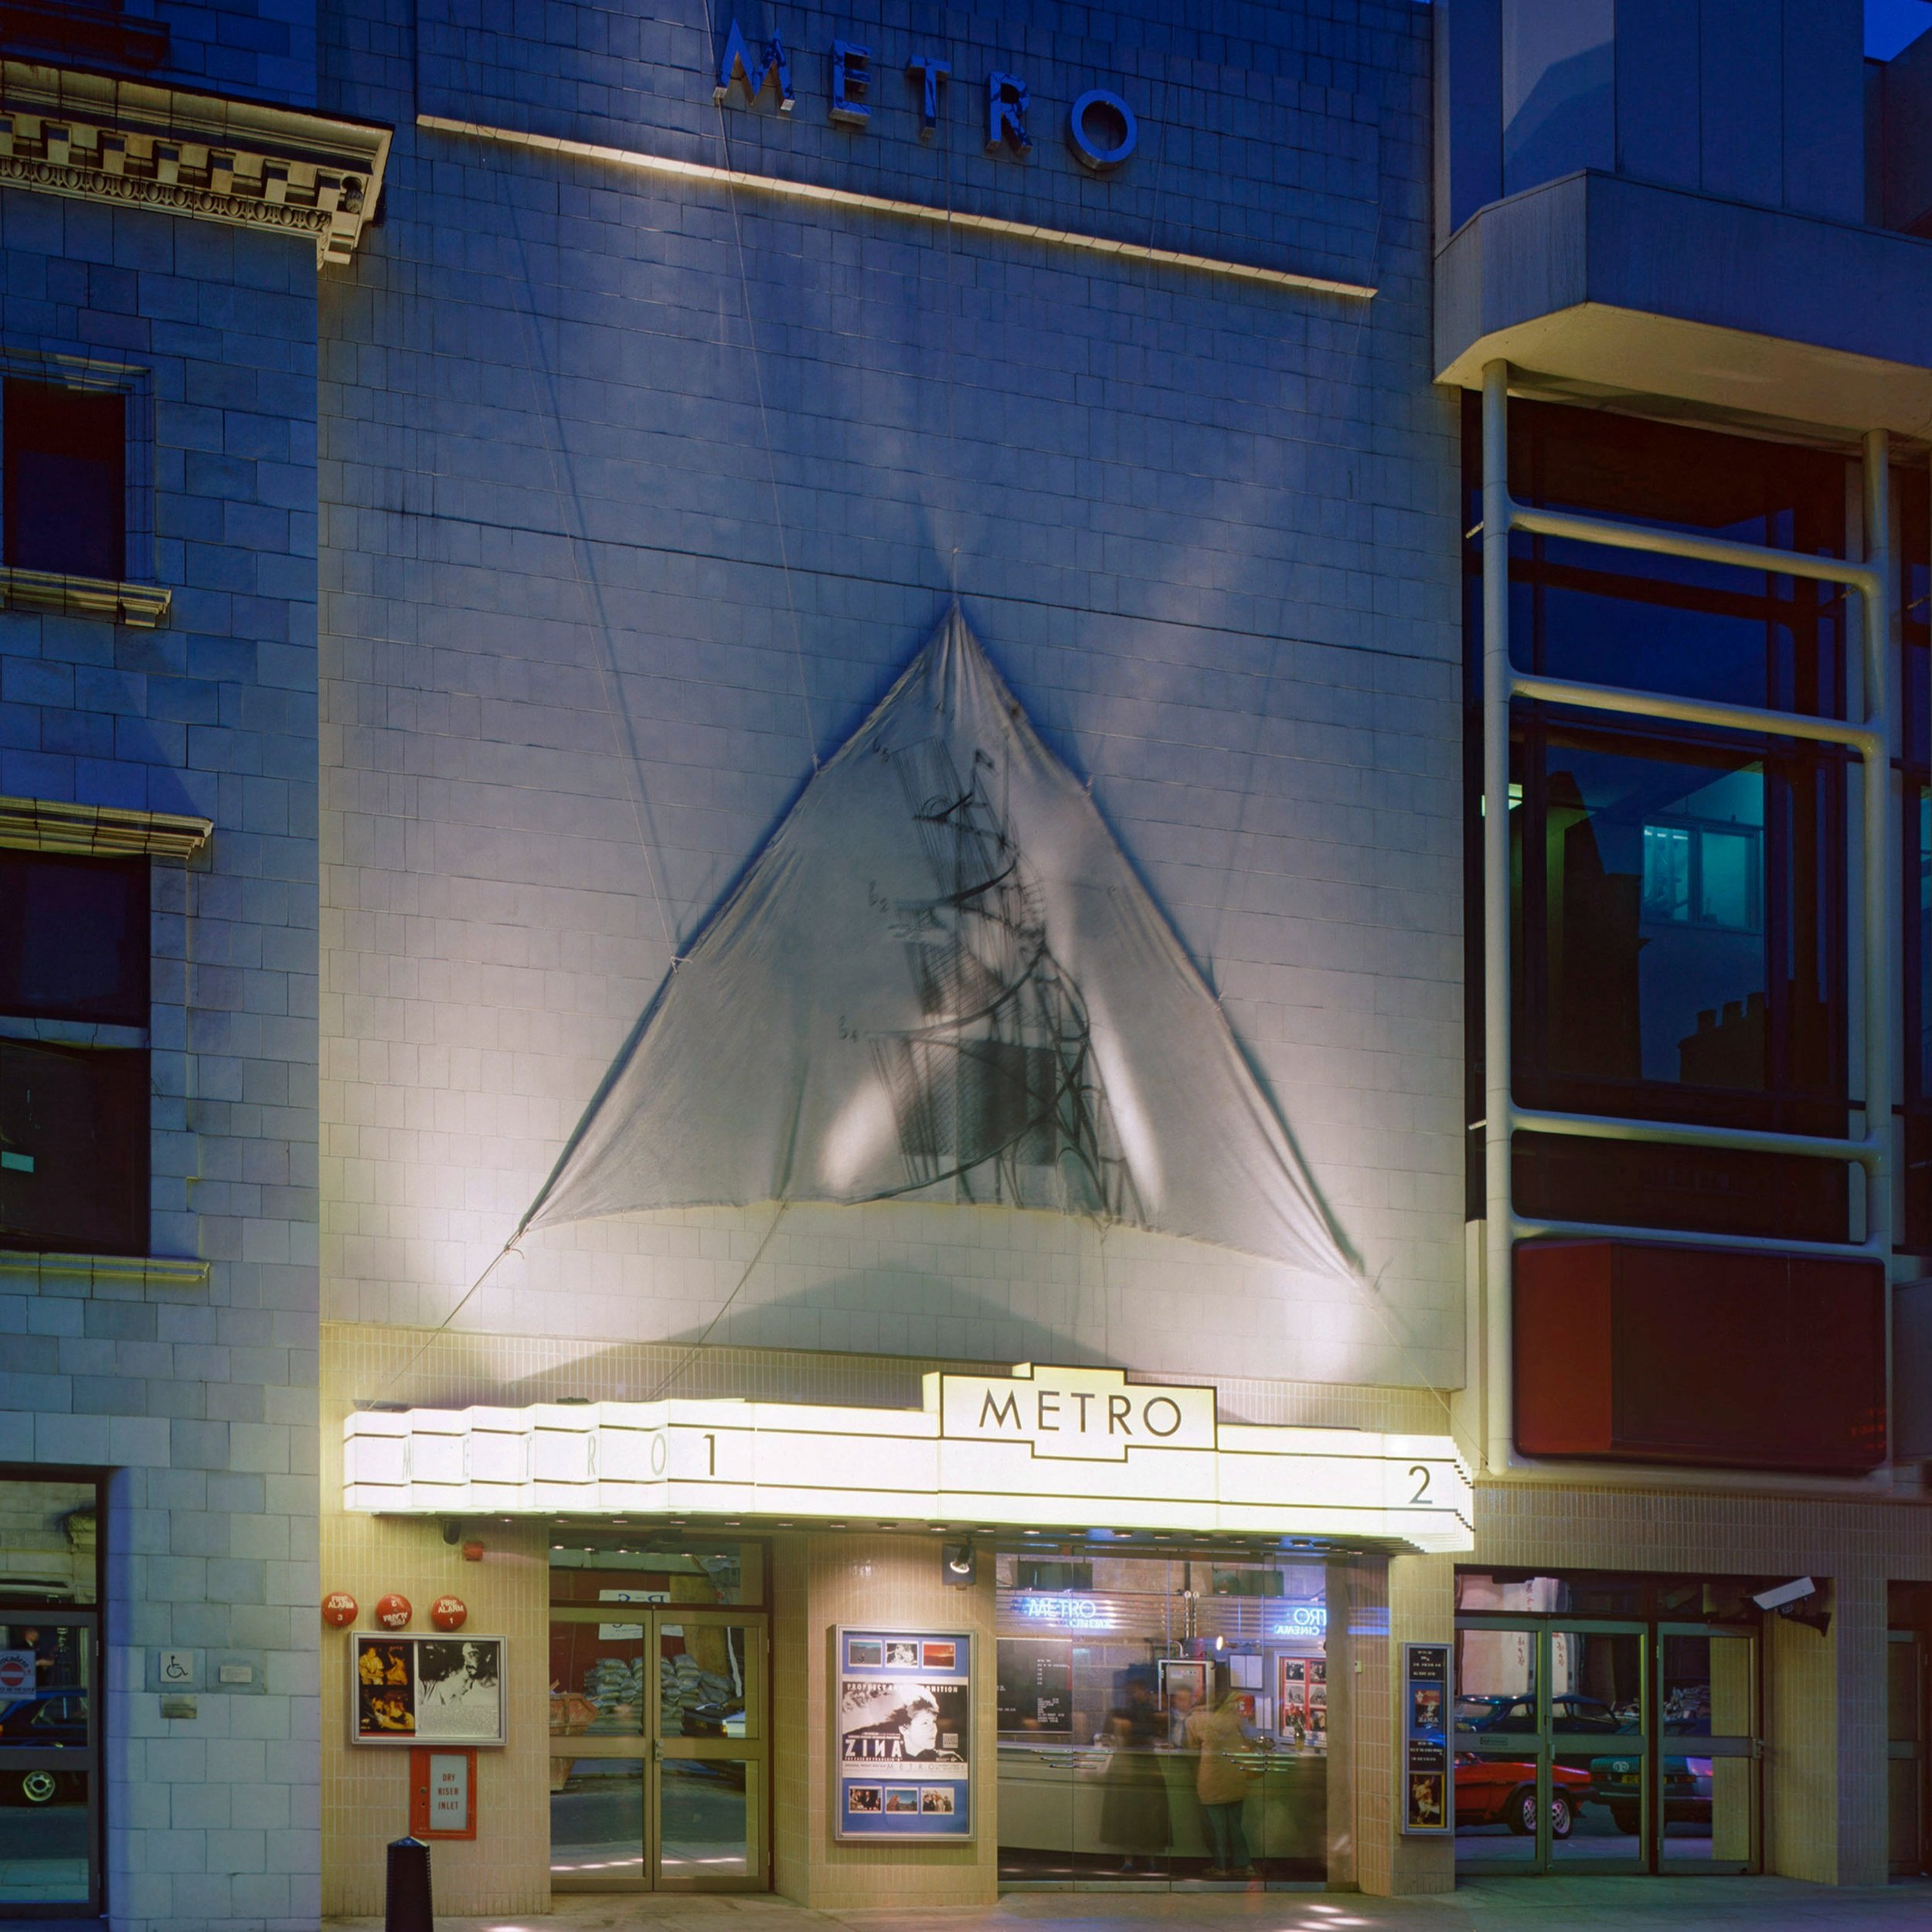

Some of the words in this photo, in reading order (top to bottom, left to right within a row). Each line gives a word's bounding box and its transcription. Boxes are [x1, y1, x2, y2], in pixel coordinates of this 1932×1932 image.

[713, 18, 1138, 171] METRO
[979, 1389, 1182, 1437] METRO
[703, 1434, 716, 1476] 1
[1408, 1465, 1434, 1505] 2
[438, 1605, 464, 1614] ALARM
[1028, 1599, 1096, 1618] METRO
[383, 1612, 408, 1622] ALARM
[442, 1773, 455, 1782] DRY
[437, 1787, 459, 1796] RISER
[438, 1801, 458, 1810] INLET
